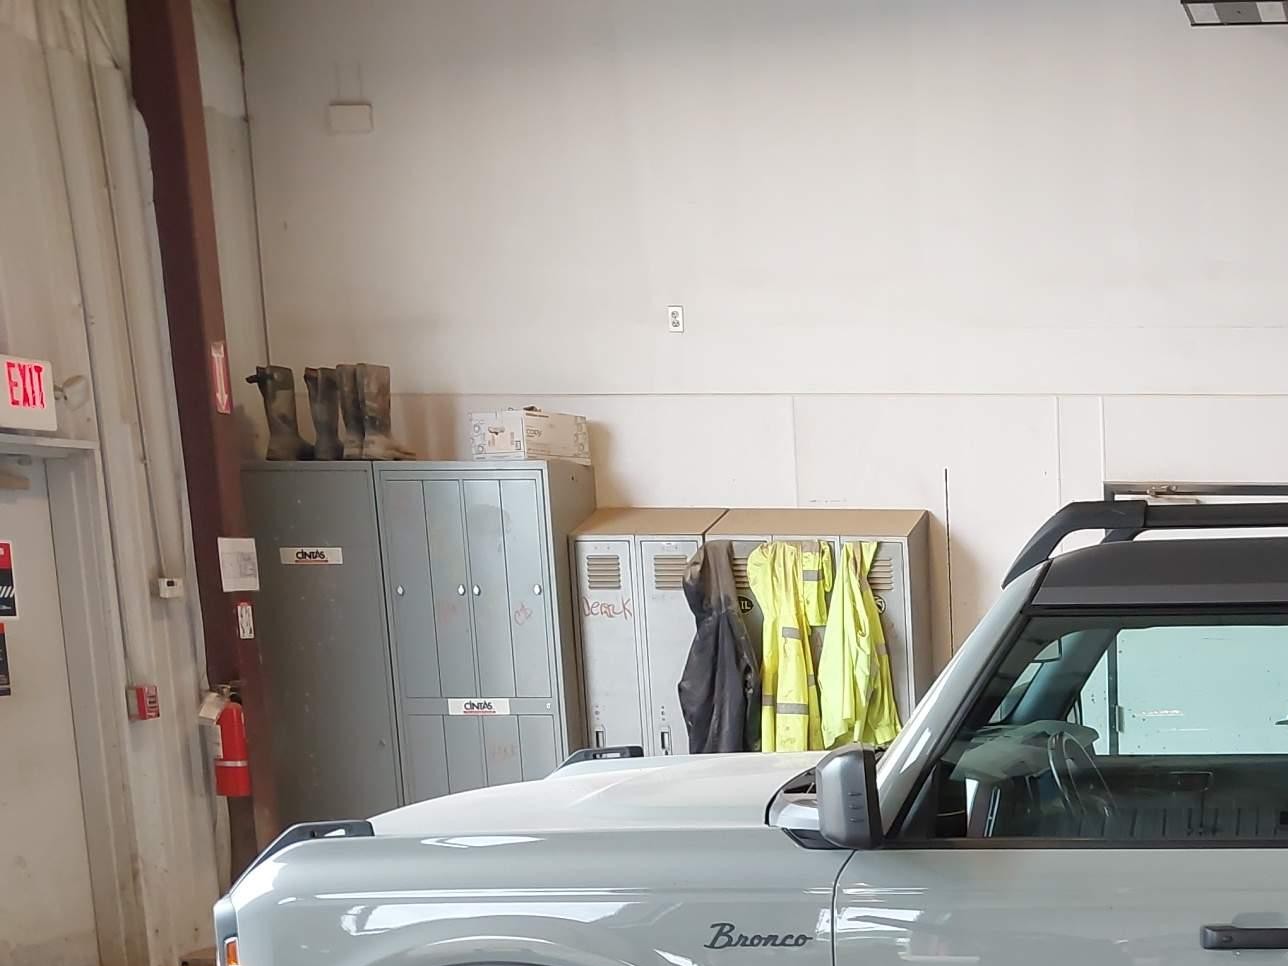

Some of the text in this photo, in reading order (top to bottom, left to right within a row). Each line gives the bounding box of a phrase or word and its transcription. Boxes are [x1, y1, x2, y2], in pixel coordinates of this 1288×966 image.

[5, 361, 46, 409] EXIT
[295, 548, 326, 560] CINTAS
[463, 700, 494, 711] CINTAS
[703, 922, 813, 948] Bronco
